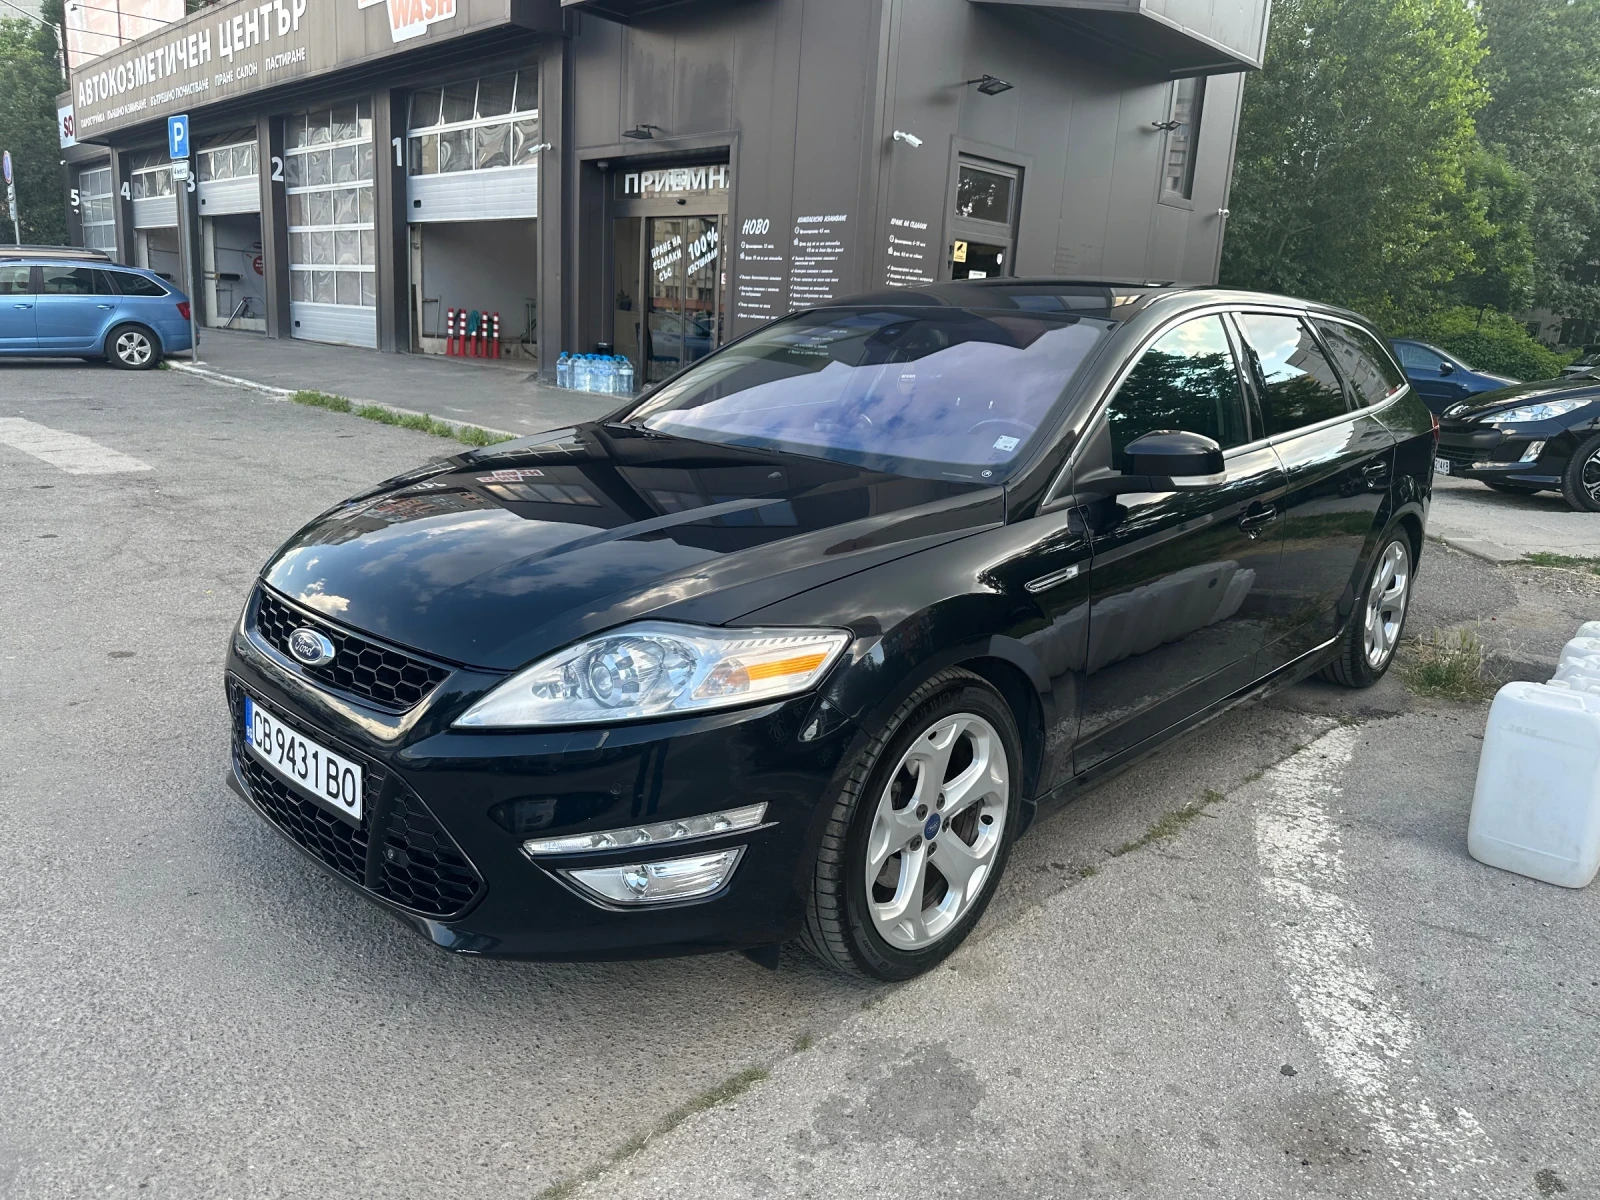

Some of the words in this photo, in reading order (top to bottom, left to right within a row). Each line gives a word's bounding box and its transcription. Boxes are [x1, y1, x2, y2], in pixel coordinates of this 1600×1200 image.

[391, 0, 453, 30] WASH
[78, 28, 211, 108] АВТОКОЗМЕТИЧЕН
[218, 0, 307, 62] ЦЕНТЪР
[215, 70, 234, 87] ПРАНЕ
[236, 62, 258, 79] САЛОН
[265, 47, 306, 71] ПАСТИРАНЕ
[173, 122, 184, 152] P
[392, 137, 403, 167] 1
[187, 170, 196, 192] 3
[271, 157, 285, 182] 2
[624, 167, 729, 194] ПРИЕМН
[70, 189, 79, 206] 5
[120, 182, 130, 200] 4
[742, 218, 770, 235] НОВО
[651, 240, 672, 258] ПРАНЕ
[672, 235, 681, 247] НА
[688, 226, 718, 260] 100%
[653, 249, 682, 271] СЕДАЛКИ
[659, 267, 672, 282] СЪС
[294, 635, 317, 657] Ford
[254, 710, 272, 755] CB
[275, 727, 319, 789] 9431
[326, 756, 356, 808] BO
